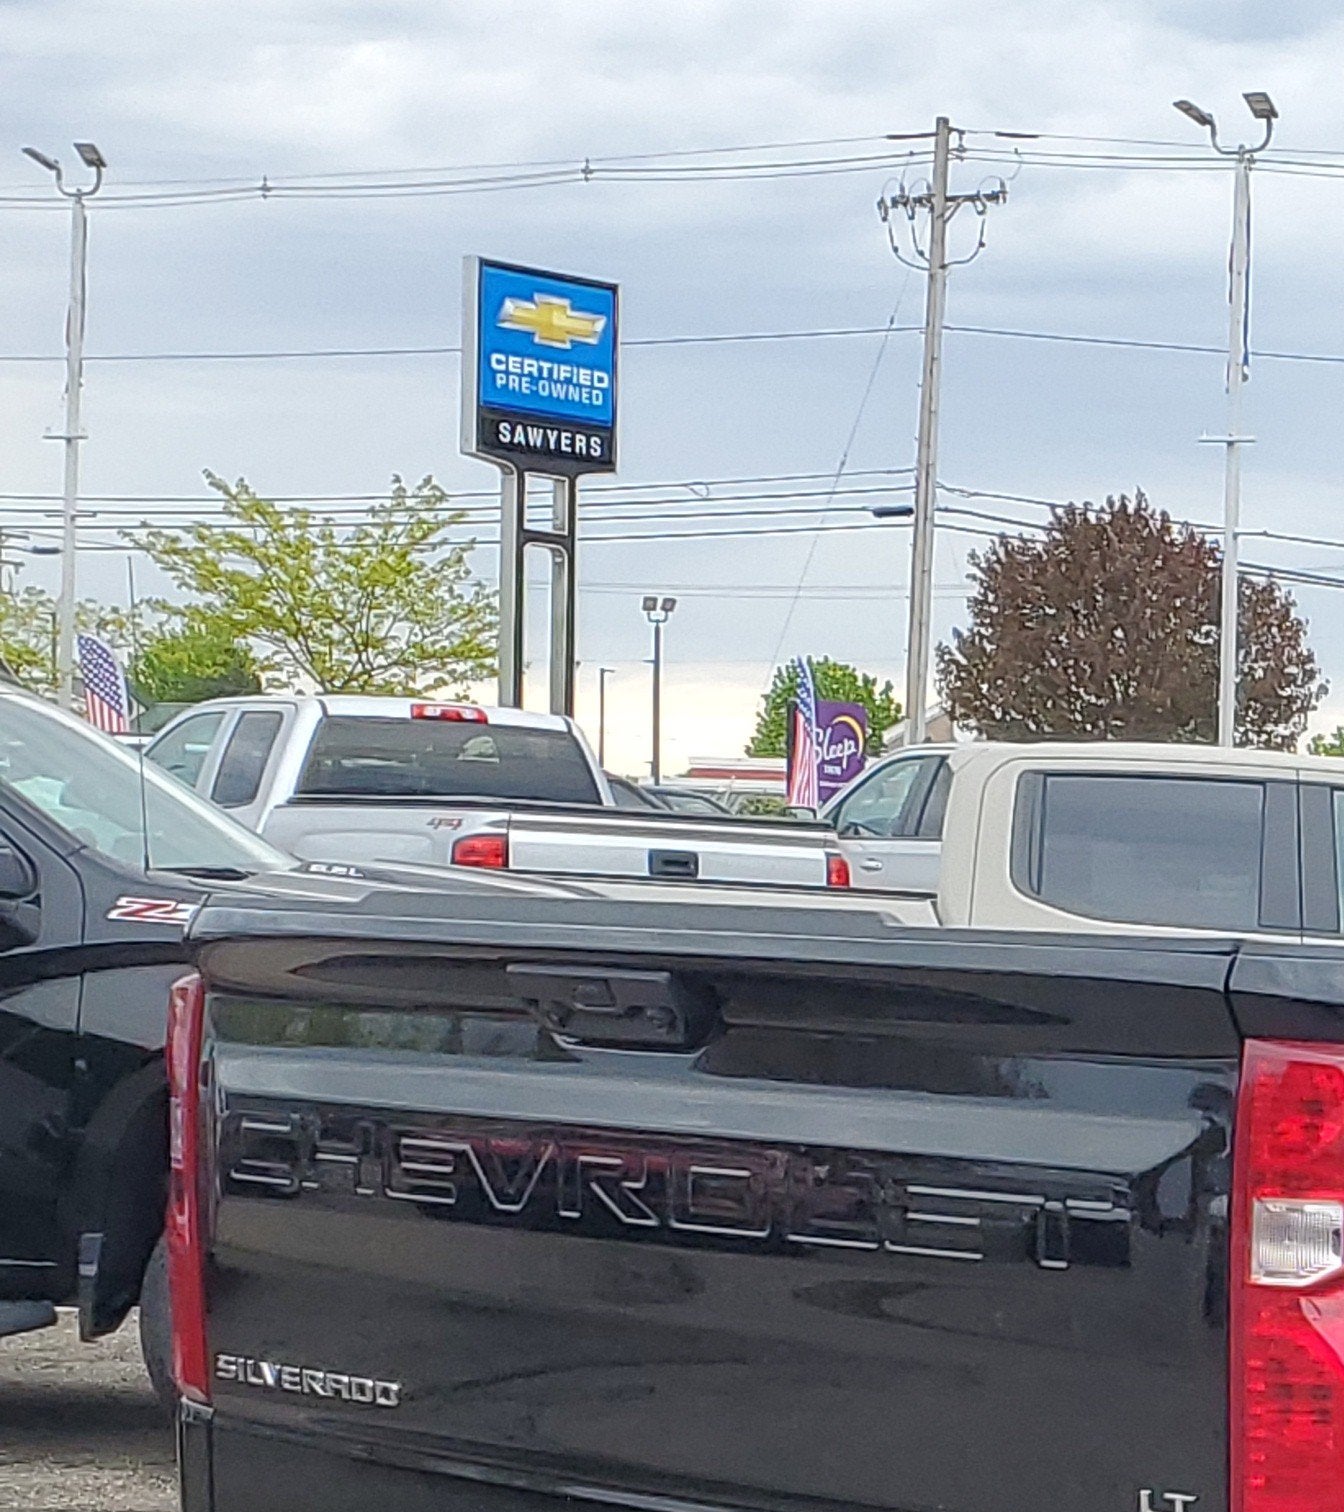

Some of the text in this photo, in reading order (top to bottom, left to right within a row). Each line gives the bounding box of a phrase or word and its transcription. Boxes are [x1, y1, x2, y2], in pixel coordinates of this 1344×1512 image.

[490, 353, 609, 388] CERTIFIED
[495, 373, 604, 406] PRE-OWNED
[498, 422, 602, 456] SAWYERS
[222, 1110, 1133, 1269] CHEVROLET
[215, 1353, 401, 1407] SILVERADO
